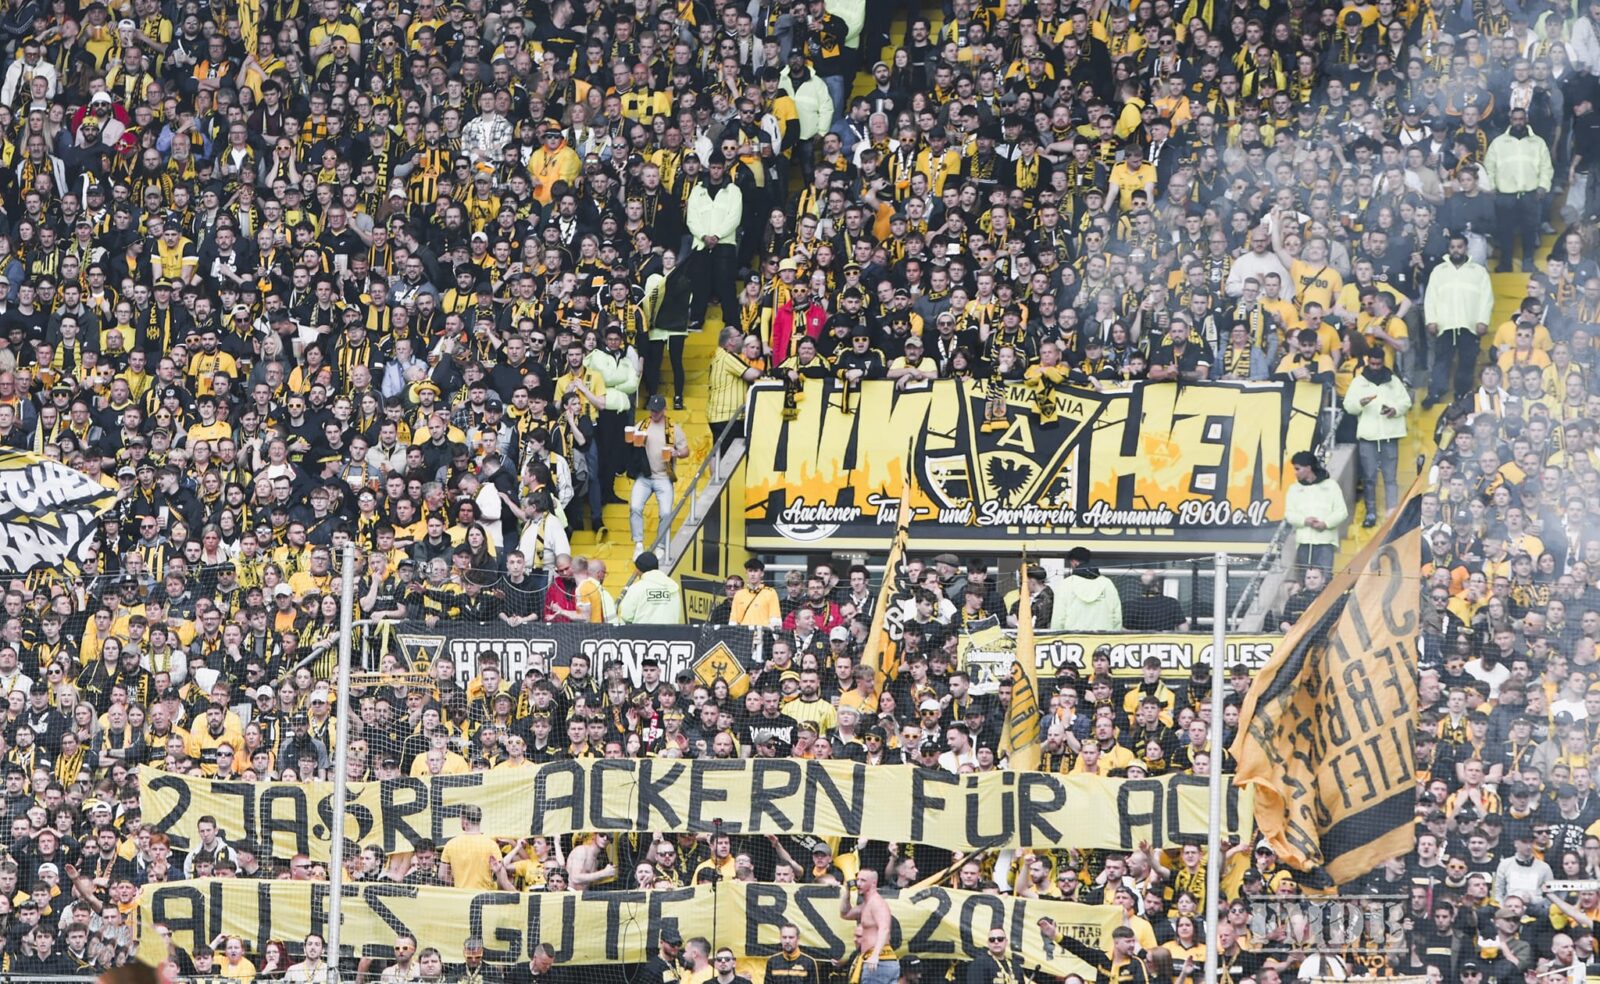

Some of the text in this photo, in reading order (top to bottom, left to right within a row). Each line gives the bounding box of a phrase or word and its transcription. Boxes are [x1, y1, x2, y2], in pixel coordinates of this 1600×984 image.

[783, 497, 861, 524] Aachener
[867, 494, 929, 526] Tu-
[938, 501, 971, 524] und
[976, 500, 1077, 526] Sportverein
[1082, 500, 1175, 527] Alemannia
[1178, 499, 1233, 526] 1900
[1034, 640, 1086, 670] FÜR
[1093, 644, 1194, 670] ACHEN
[1198, 643, 1274, 670] ALES
[148, 775, 191, 849] 2
[531, 758, 866, 836] ACKERN
[910, 767, 1067, 848] FÜR
